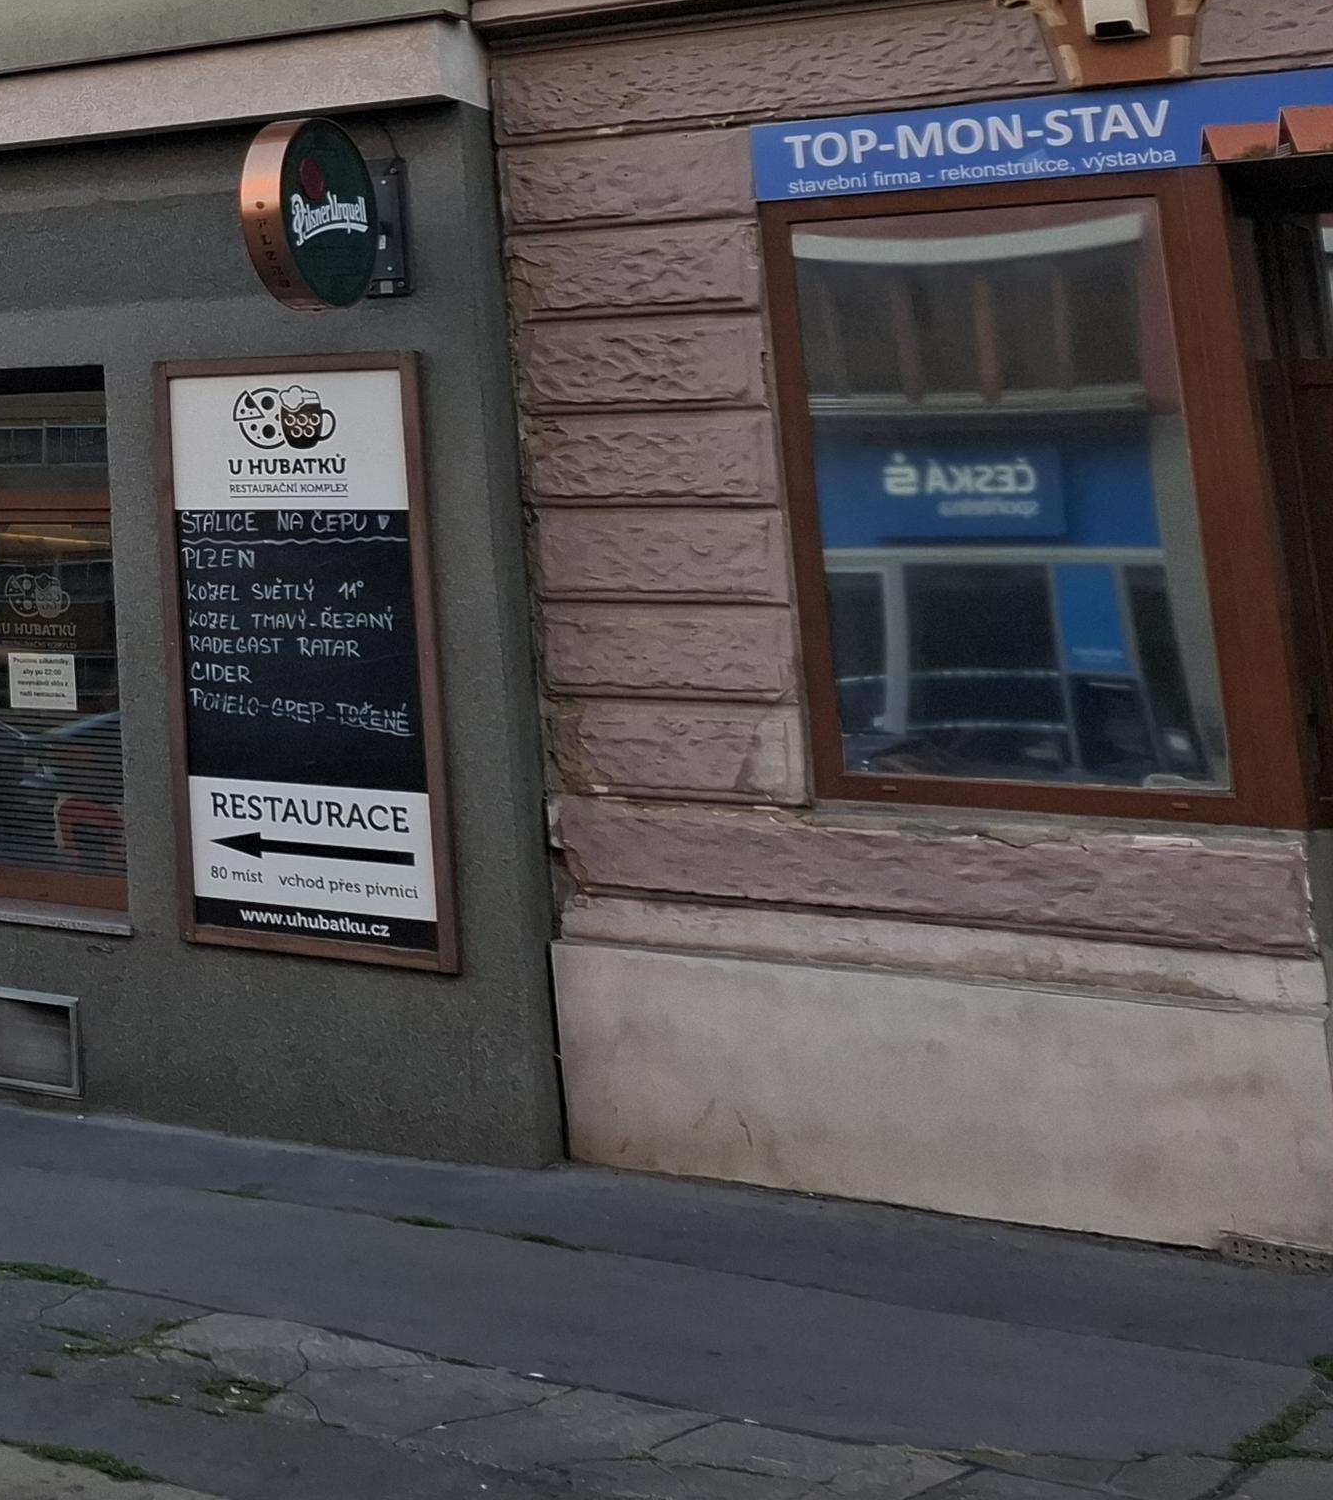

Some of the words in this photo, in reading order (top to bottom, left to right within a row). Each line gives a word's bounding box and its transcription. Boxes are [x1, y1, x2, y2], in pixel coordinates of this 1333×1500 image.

[783, 100, 1170, 169] TOP-MON-STAV
[788, 172, 867, 195] stavební
[873, 168, 921, 188] firma
[940, 156, 1076, 183] rekonstrukce,
[1081, 148, 1177, 173] výstavba
[290, 193, 332, 247] Pilsner
[326, 190, 368, 234] Urquell
[228, 458, 243, 475] U
[247, 453, 347, 475] HUBATKŮ
[229, 482, 298, 493] RESTAURAČNÍ
[300, 483, 349, 494] KOMPLEX
[181, 510, 259, 534] STÁLICE
[276, 512, 304, 532] NA
[310, 510, 368, 533] ČEPU
[186, 579, 240, 601] KOZEL
[251, 578, 315, 601] SVĚTLÝ
[2, 622, 10, 634] U
[14, 622, 77, 637] HUBATKŮ
[188, 608, 241, 630] KOZEL
[189, 635, 285, 655] RADEGAST
[296, 636, 361, 658] RATAR
[190, 661, 253, 684] CIDER
[210, 791, 410, 834] RESTAURACE
[210, 865, 228, 880] 80
[231, 868, 264, 884] míst
[278, 873, 325, 890] vchod
[328, 878, 362, 894] přes
[364, 882, 419, 900] pivnici
[239, 908, 391, 938] www.uhubatku.cz
